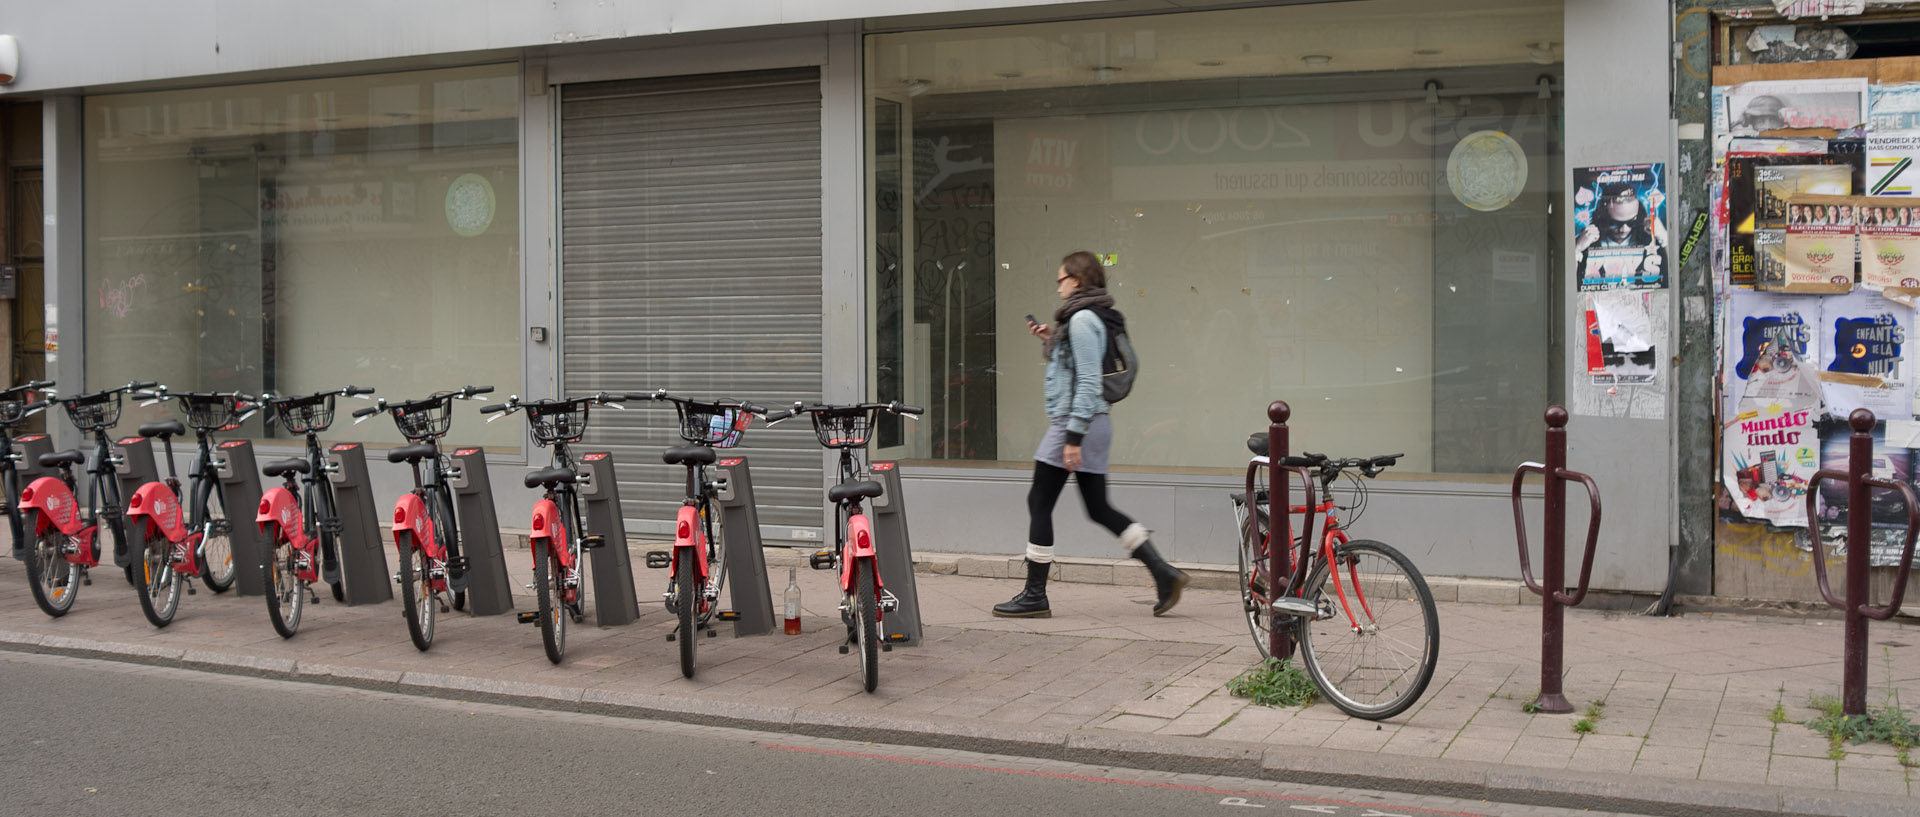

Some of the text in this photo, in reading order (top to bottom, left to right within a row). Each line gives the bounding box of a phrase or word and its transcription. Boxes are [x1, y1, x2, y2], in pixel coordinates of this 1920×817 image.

[1732, 245, 1745, 255] LE
[1781, 311, 1799, 324] LES
[1874, 312, 1893, 325] LES
[1856, 324, 1905, 344] ENFANTS
[1880, 344, 1893, 356] LA
[1868, 357, 1905, 380] NUIT
[1741, 411, 1809, 434] Mundo
[1801, 448, 1809, 456] 7
